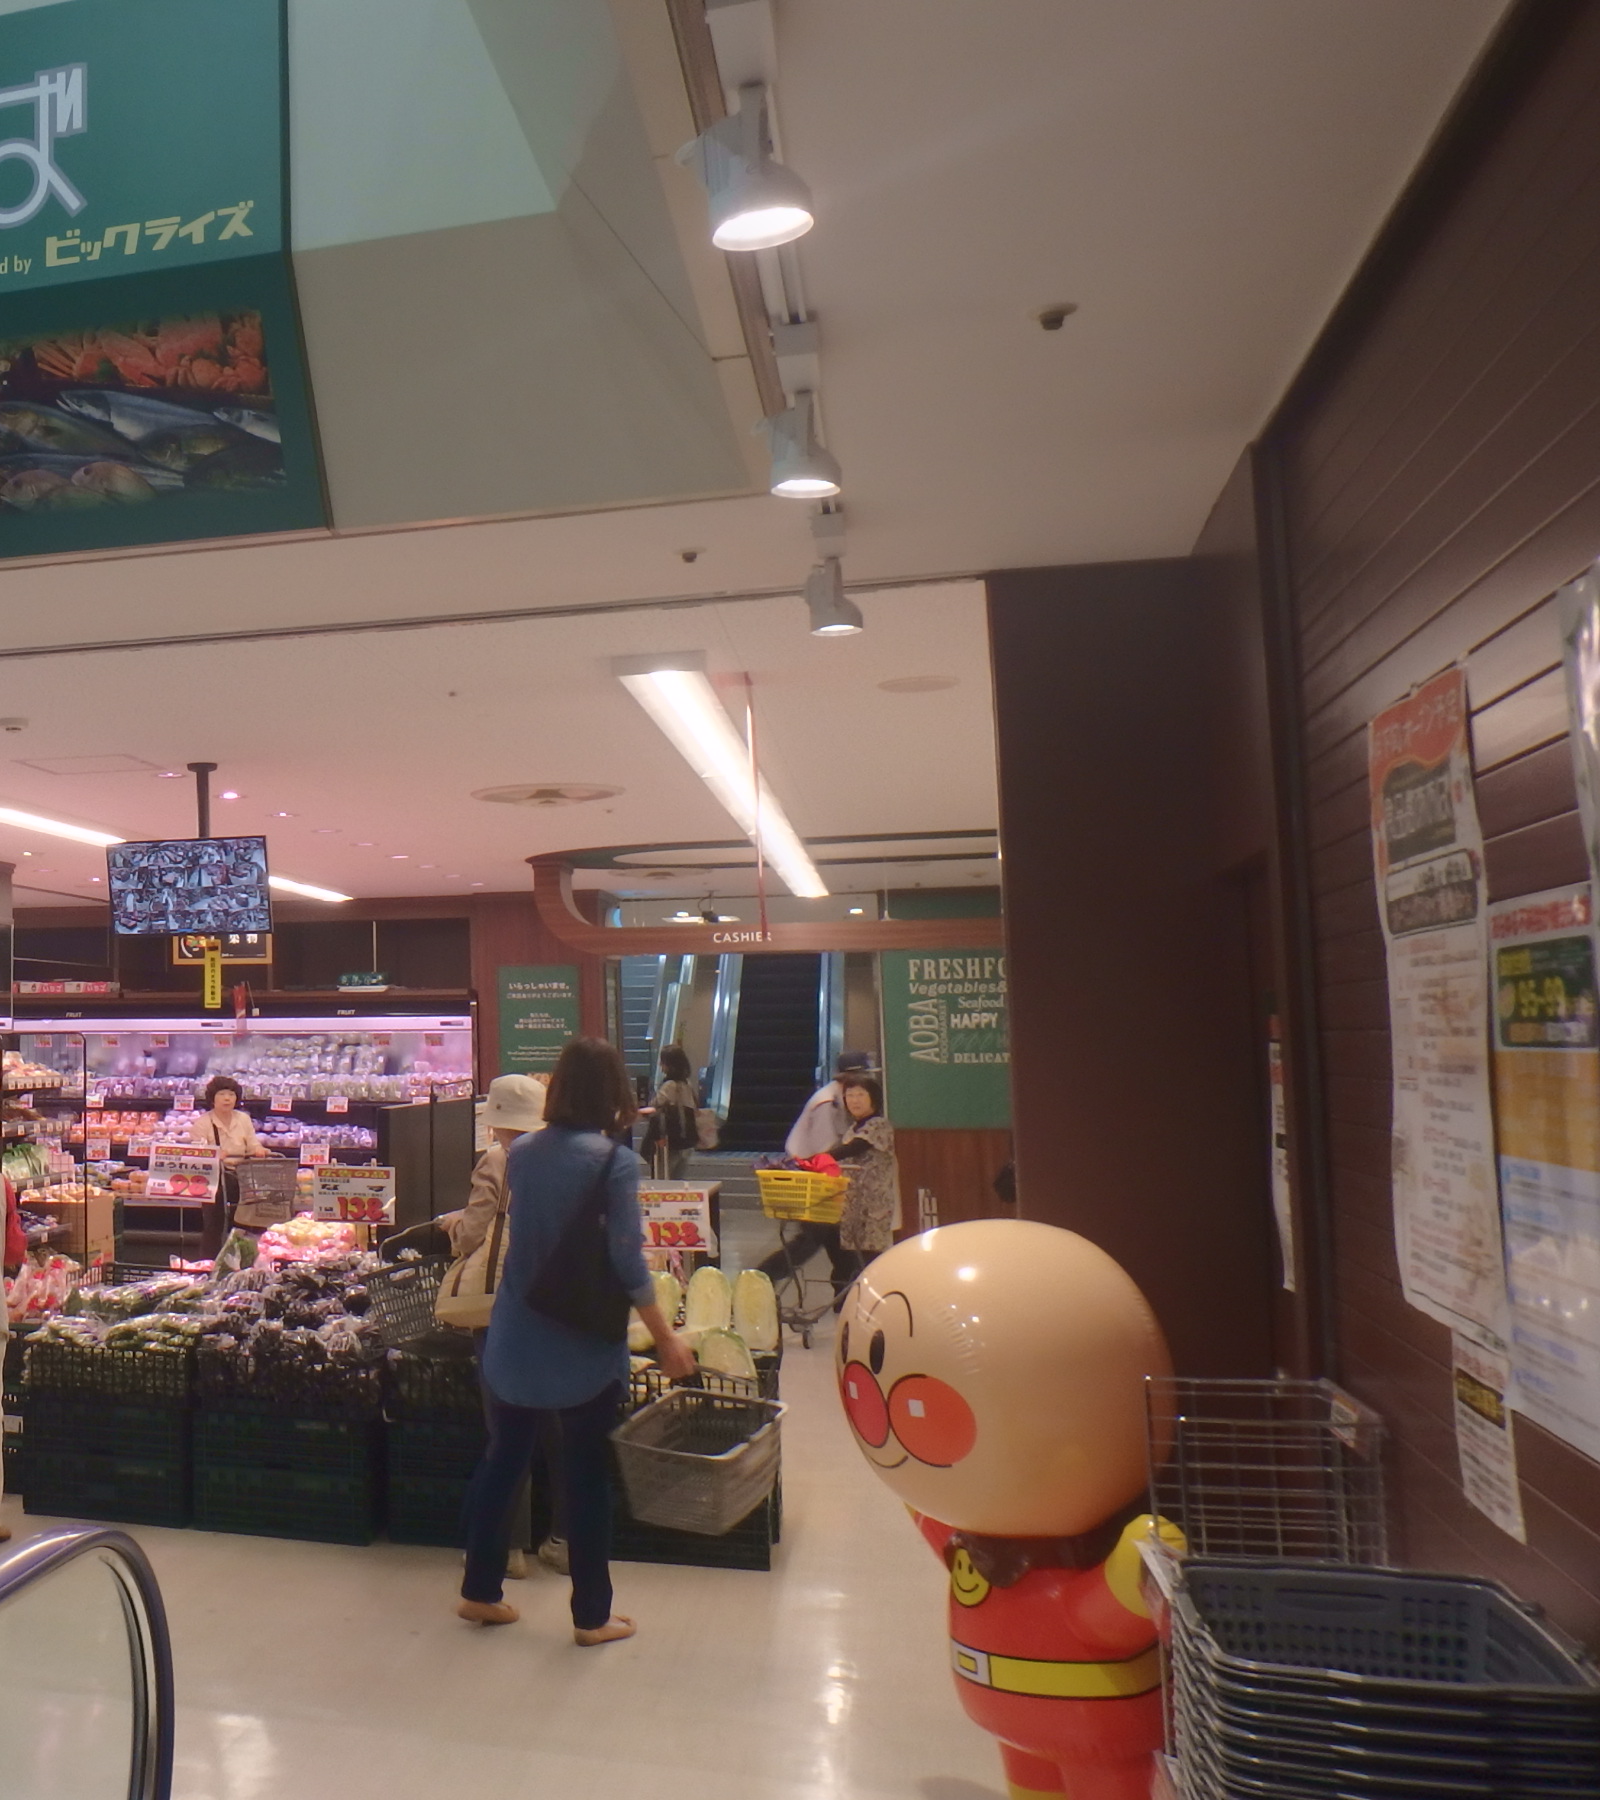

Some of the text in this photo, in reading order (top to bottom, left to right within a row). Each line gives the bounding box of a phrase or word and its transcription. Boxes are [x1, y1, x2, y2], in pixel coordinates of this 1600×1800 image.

[13, 256, 32, 275] by
[46, 200, 254, 267] ビックライズ
[509, 982, 570, 990] いらっしゃいませ。
[958, 994, 1005, 1012] Seafood
[950, 1012, 999, 1029] HAPPY
[908, 998, 940, 1063] AOBA
[157, 1148, 214, 1158] 広告の品
[155, 1161, 213, 1170] ほうれん草
[320, 1169, 388, 1178] 広告の品
[170, 1174, 209, 1197] 98
[337, 1196, 384, 1220] 138
[649, 1222, 700, 1246] 138
